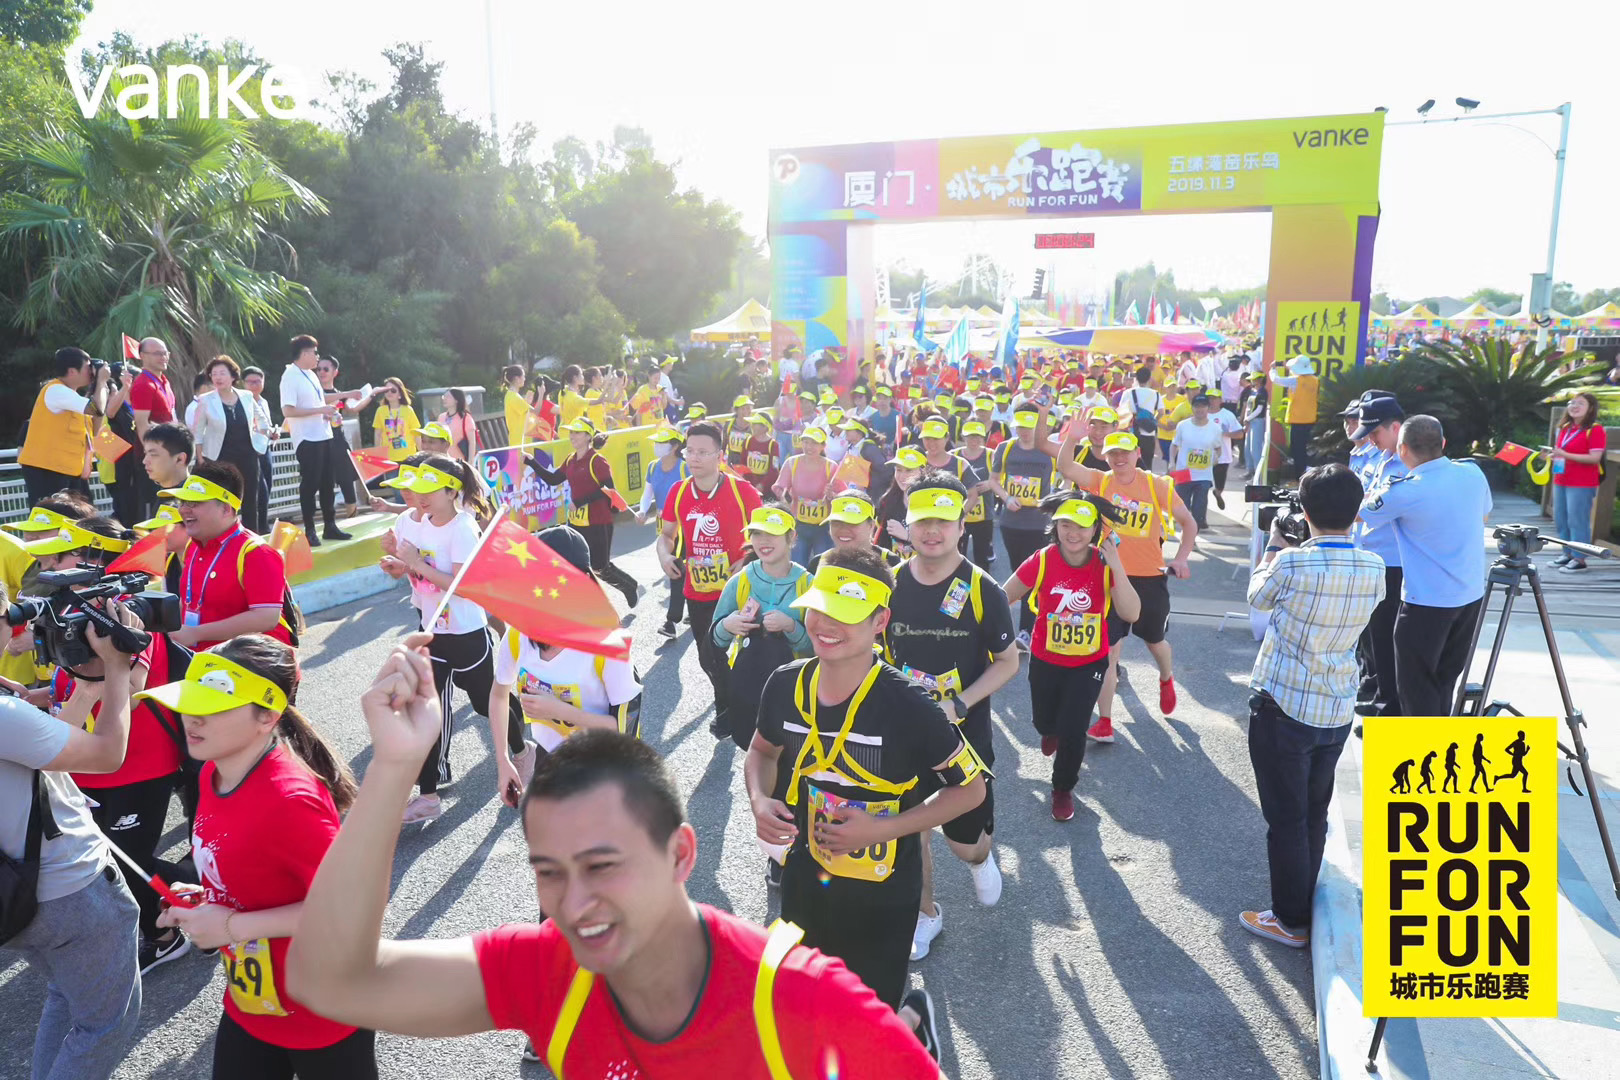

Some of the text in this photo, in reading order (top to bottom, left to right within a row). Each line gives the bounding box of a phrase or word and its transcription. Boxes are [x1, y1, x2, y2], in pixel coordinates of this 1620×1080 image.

[1292, 127, 1369, 148] vanke
[1168, 176, 1235, 192] 2019.11.3
[1008, 194, 1098, 208] RUN FOR FUN
[1285, 335, 1346, 356] RUN
[1188, 453, 1208, 465] 0738
[1010, 483, 1036, 499] 0264
[800, 503, 825, 518] 0141
[1115, 508, 1148, 529] 319
[692, 564, 730, 584] 0354
[80, 602, 115, 628] Panasonic
[890, 621, 970, 641] Champion
[1052, 622, 1096, 645] 0359
